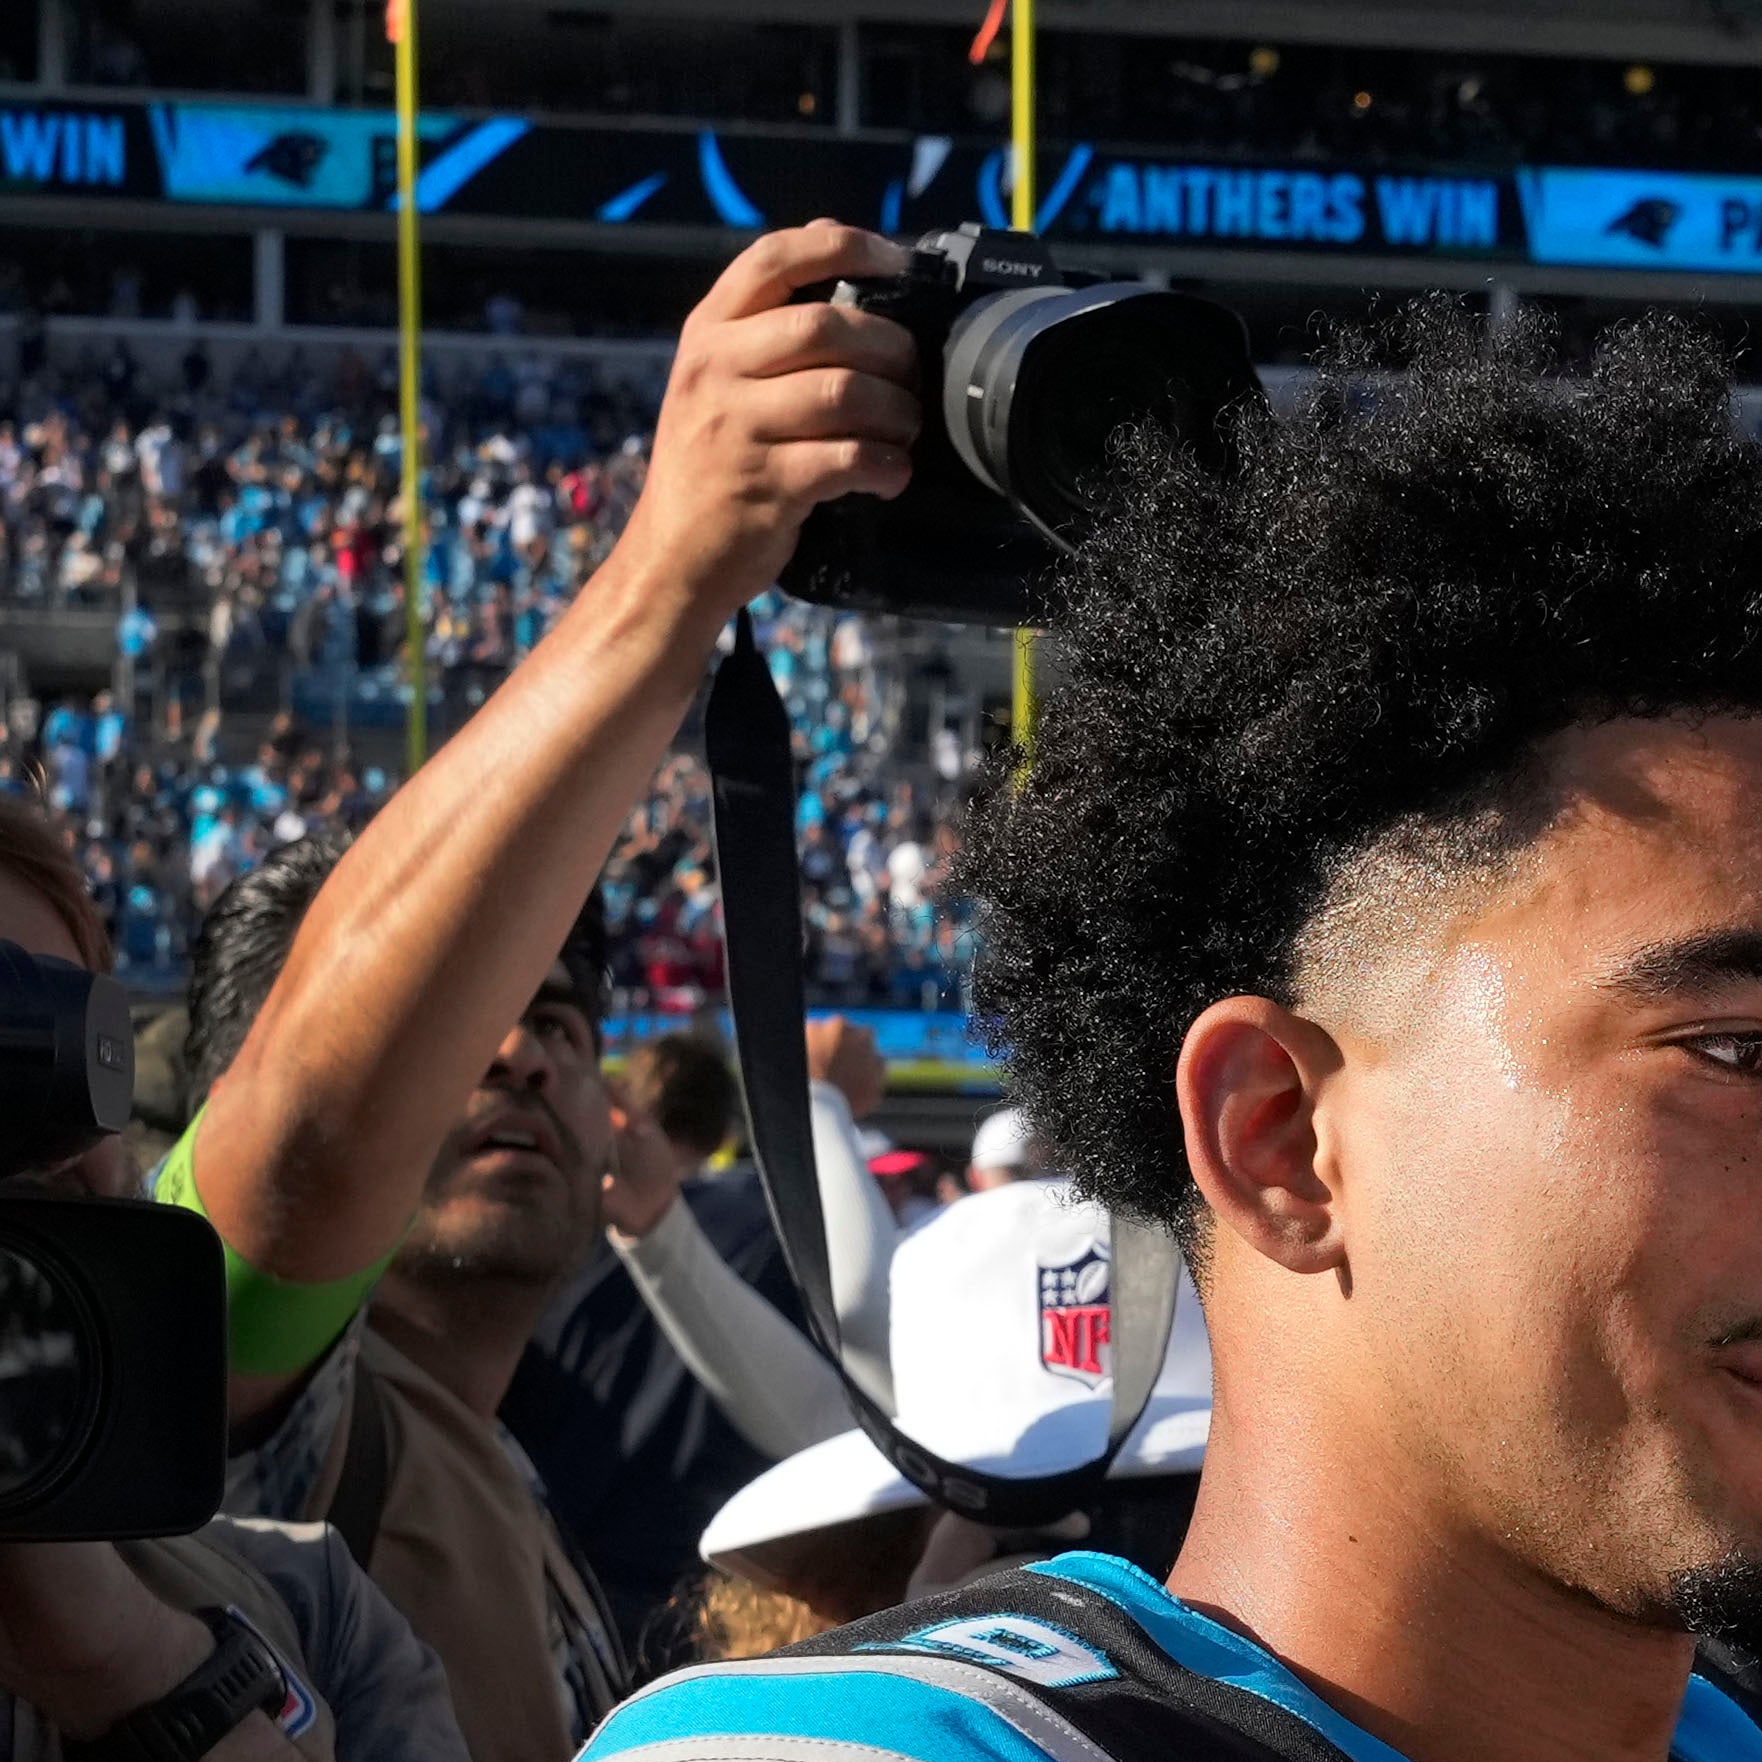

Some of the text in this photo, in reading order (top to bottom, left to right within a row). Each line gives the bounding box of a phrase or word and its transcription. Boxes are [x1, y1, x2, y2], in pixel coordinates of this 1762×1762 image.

[1, 112, 125, 185] WIN
[1100, 162, 1498, 247] ANTHERS WIN
[982, 256, 1044, 278] SONY
[1043, 1304, 1111, 1374] NF
